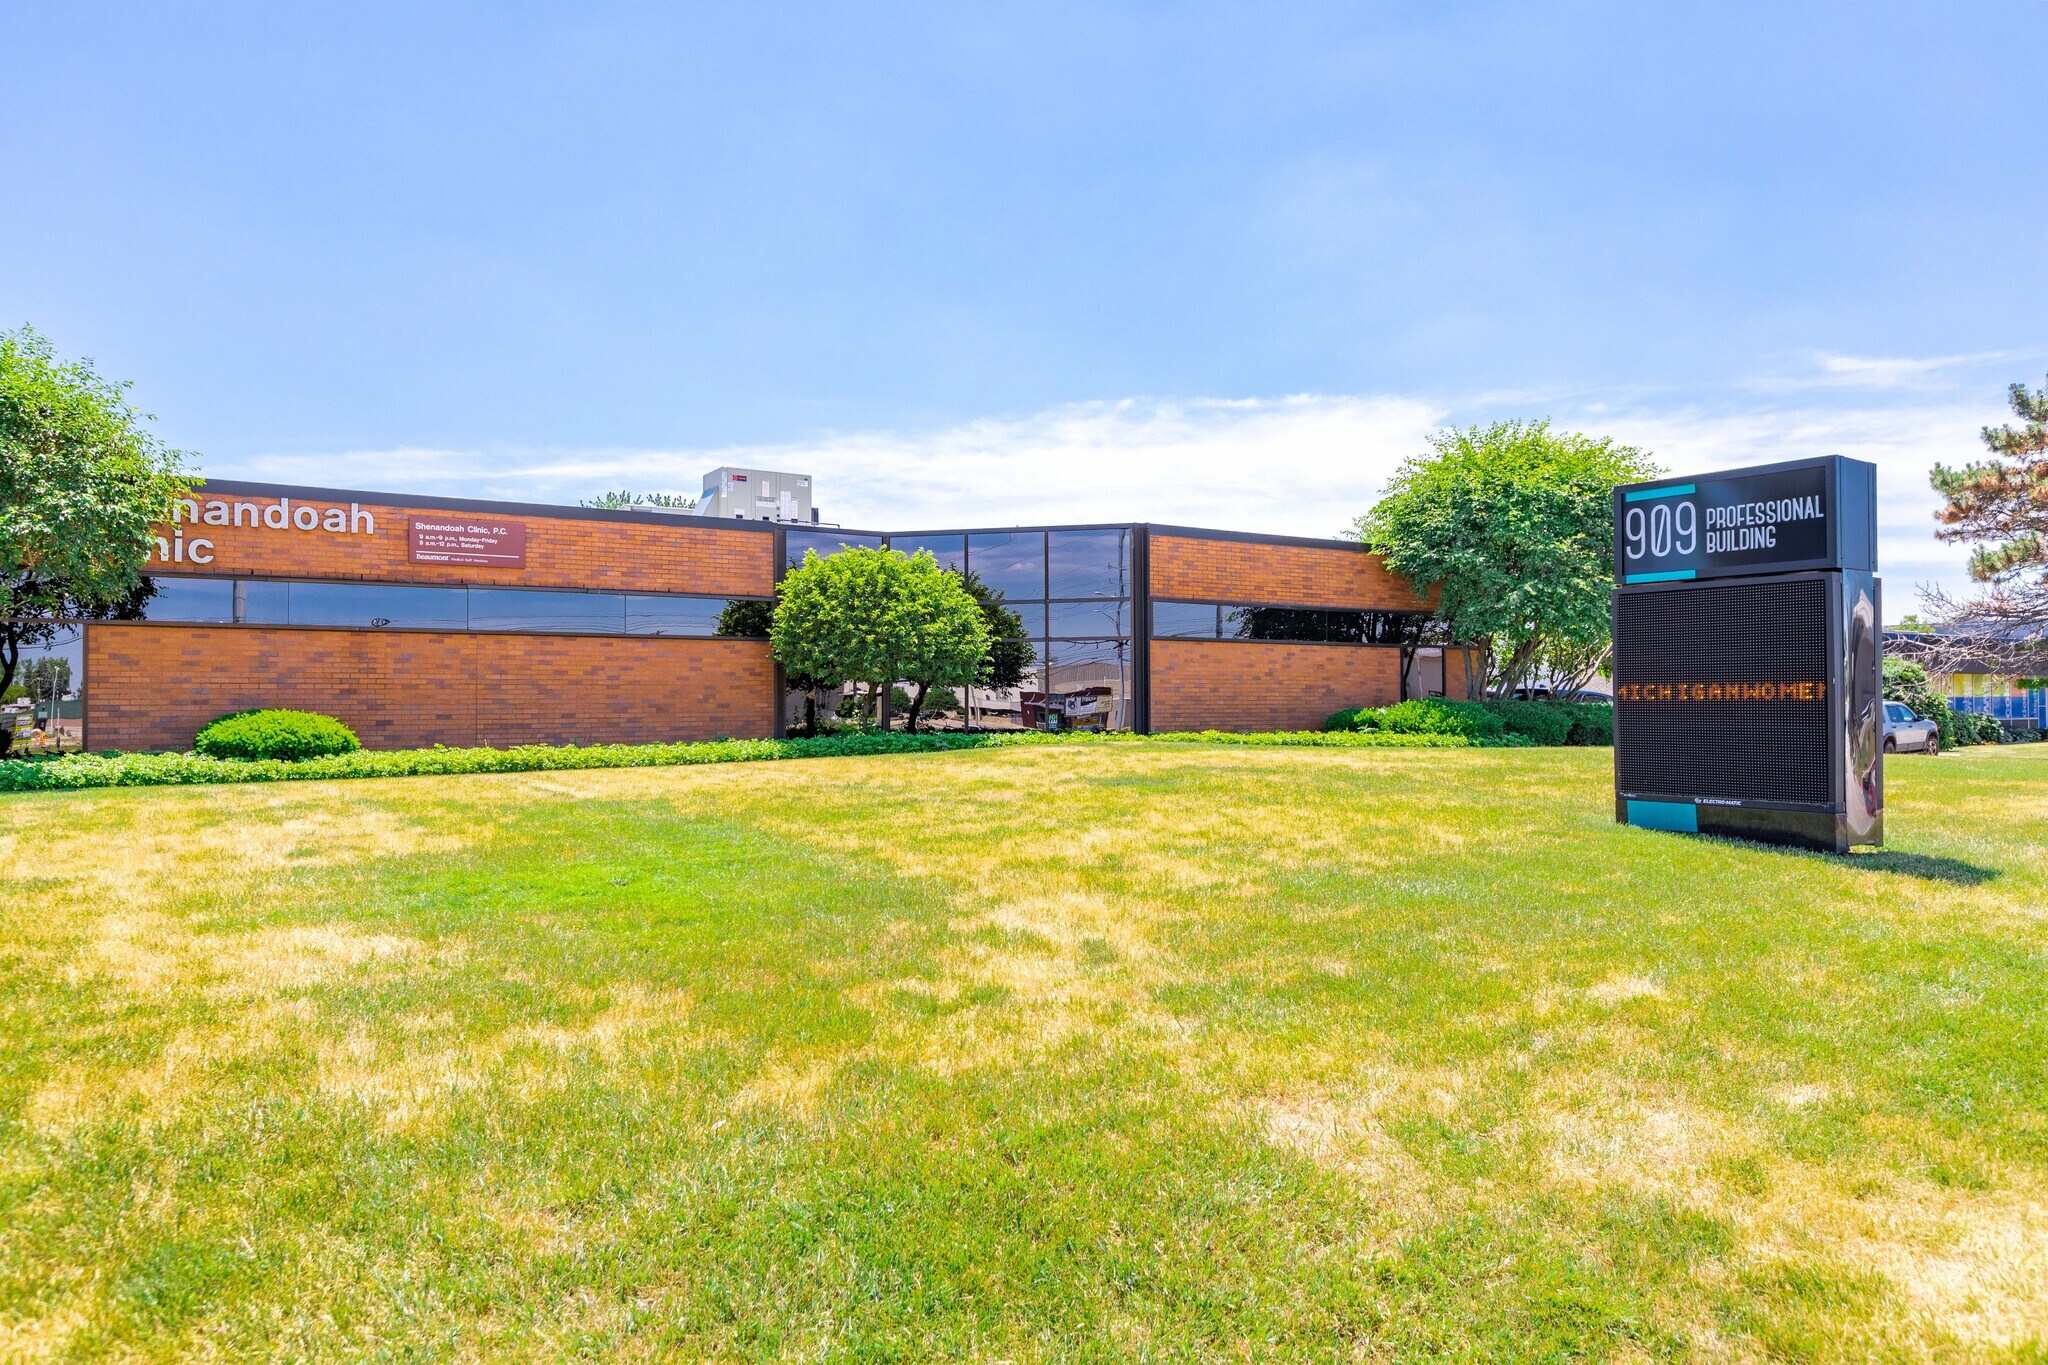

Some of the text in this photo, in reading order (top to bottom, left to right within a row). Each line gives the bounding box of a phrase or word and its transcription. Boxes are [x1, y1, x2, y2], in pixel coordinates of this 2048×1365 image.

[172, 498, 375, 535] nandoah
[1706, 495, 1825, 530] PROFESSIONAL
[415, 522, 508, 535] Shenandoah Clinic, P.C.
[458, 536, 499, 545] Monday-Friday
[1625, 501, 1697, 560] 909
[1706, 525, 1776, 554] BUILDING
[146, 529, 215, 564] nic
[416, 553, 449, 561] Beaumont
[460, 542, 485, 550] Saturday
